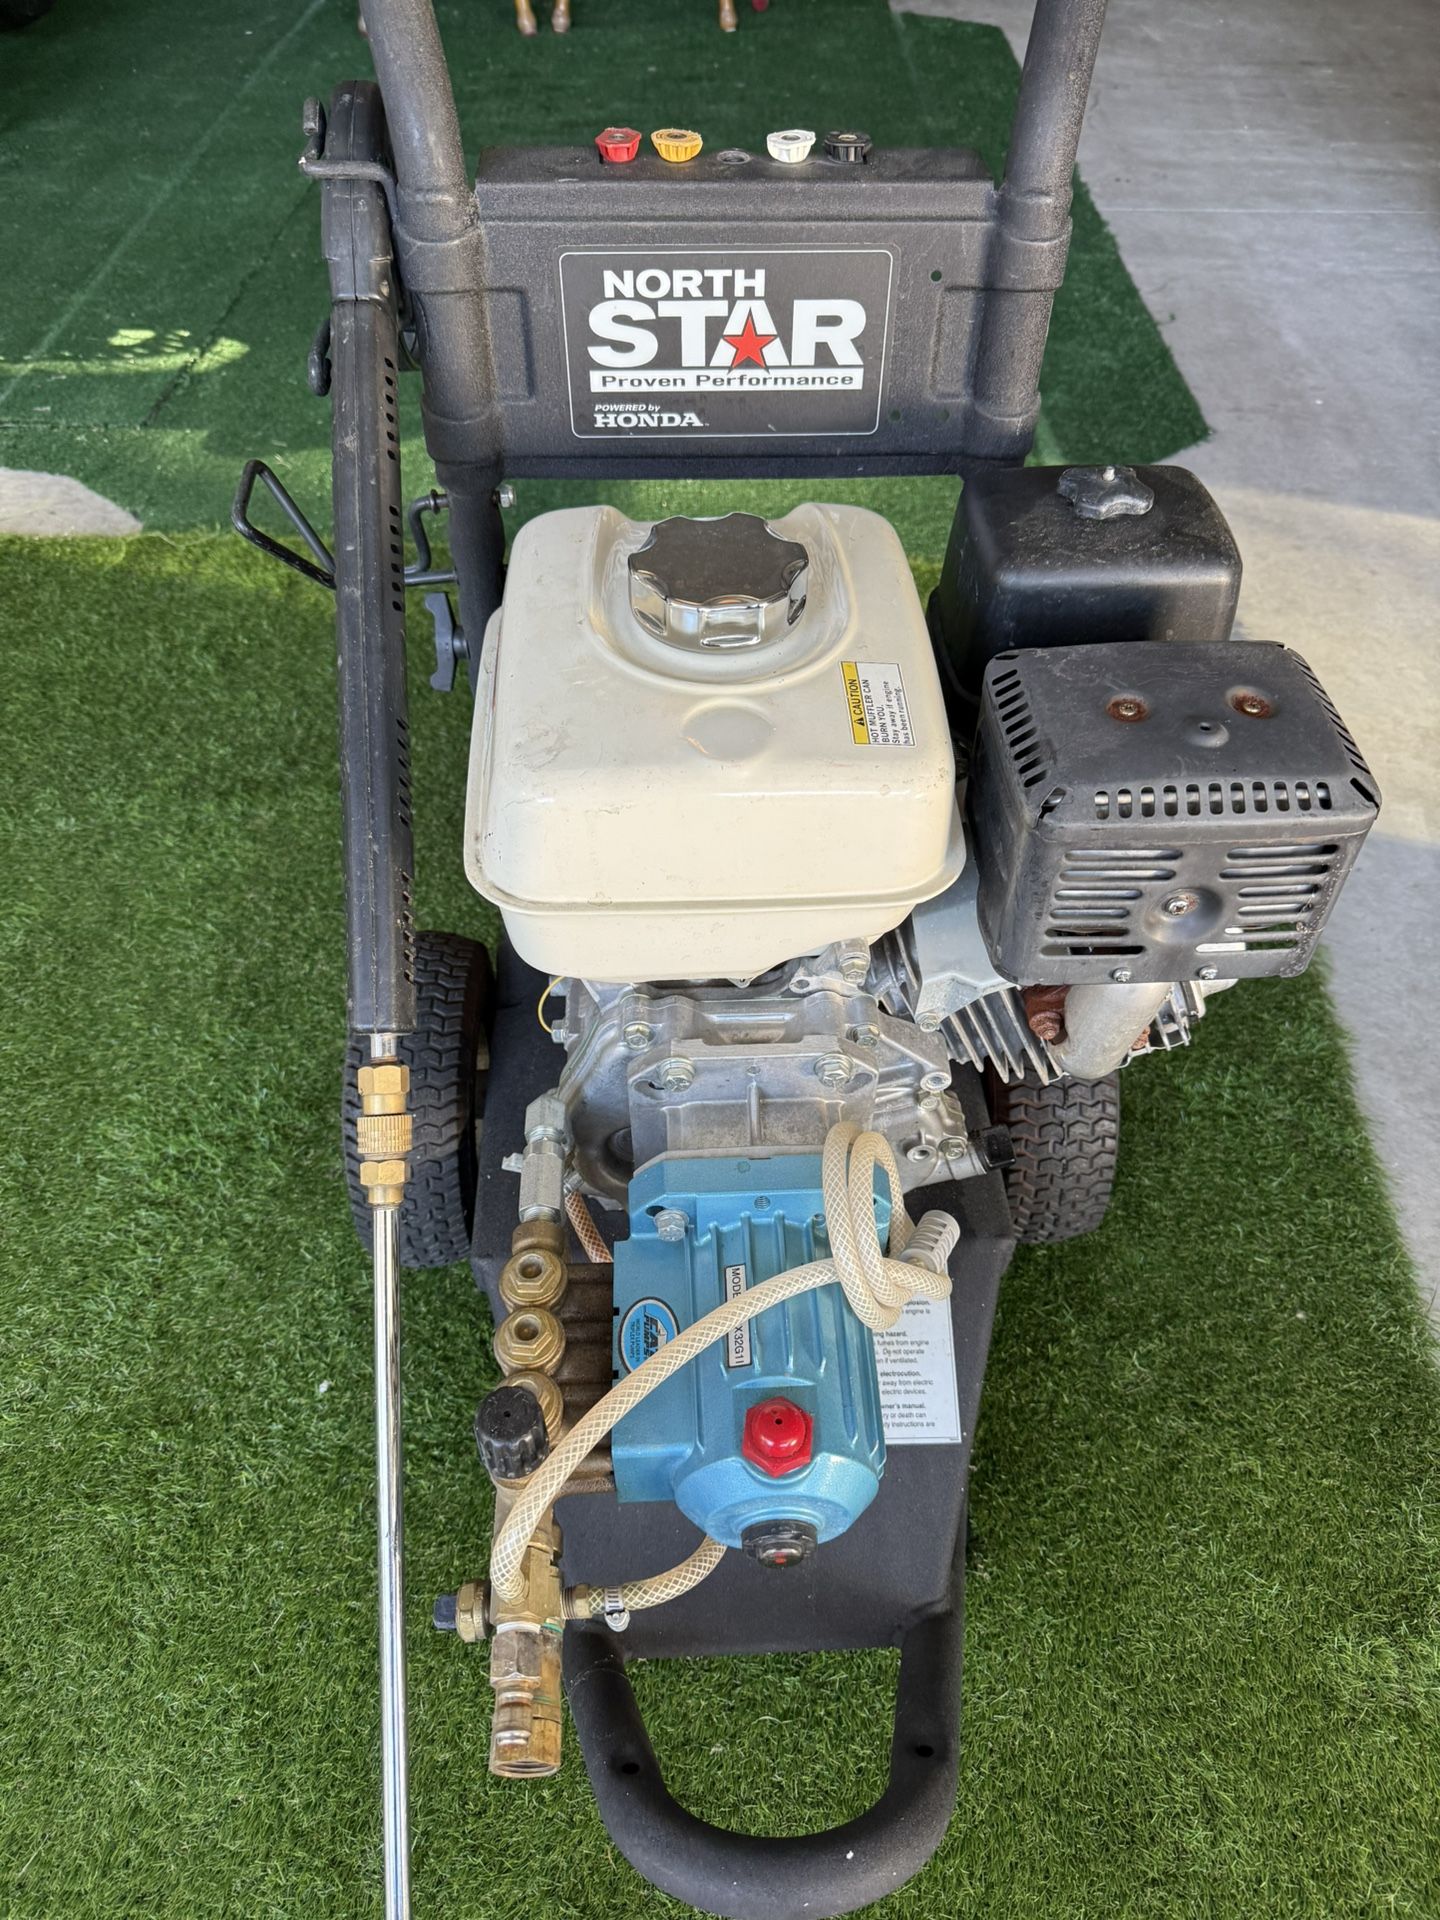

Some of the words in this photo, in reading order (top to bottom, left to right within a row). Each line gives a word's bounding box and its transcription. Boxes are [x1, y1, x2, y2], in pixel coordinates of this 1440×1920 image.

[603, 268, 766, 299] NORTH
[587, 299, 867, 368] STAR
[601, 374, 686, 388] Proven
[695, 373, 854, 388] Performance
[594, 403, 647, 412] POWERED
[648, 403, 661, 413] by
[593, 412, 704, 428] HONDA
[861, 679, 871, 693] CAN
[883, 681, 893, 702] engine
[848, 679, 863, 715] CAUTION
[894, 687, 905, 713] running.
[864, 695, 877, 726] MUFFLER
[876, 704, 886, 720] YOU.
[889, 711, 898, 727] away
[900, 714, 909, 730] been
[870, 729, 879, 742] HOT
[879, 722, 890, 742] BURN
[891, 729, 900, 743] Stay
[902, 732, 911, 744] has
[732, 1268, 741, 1298] MODE
